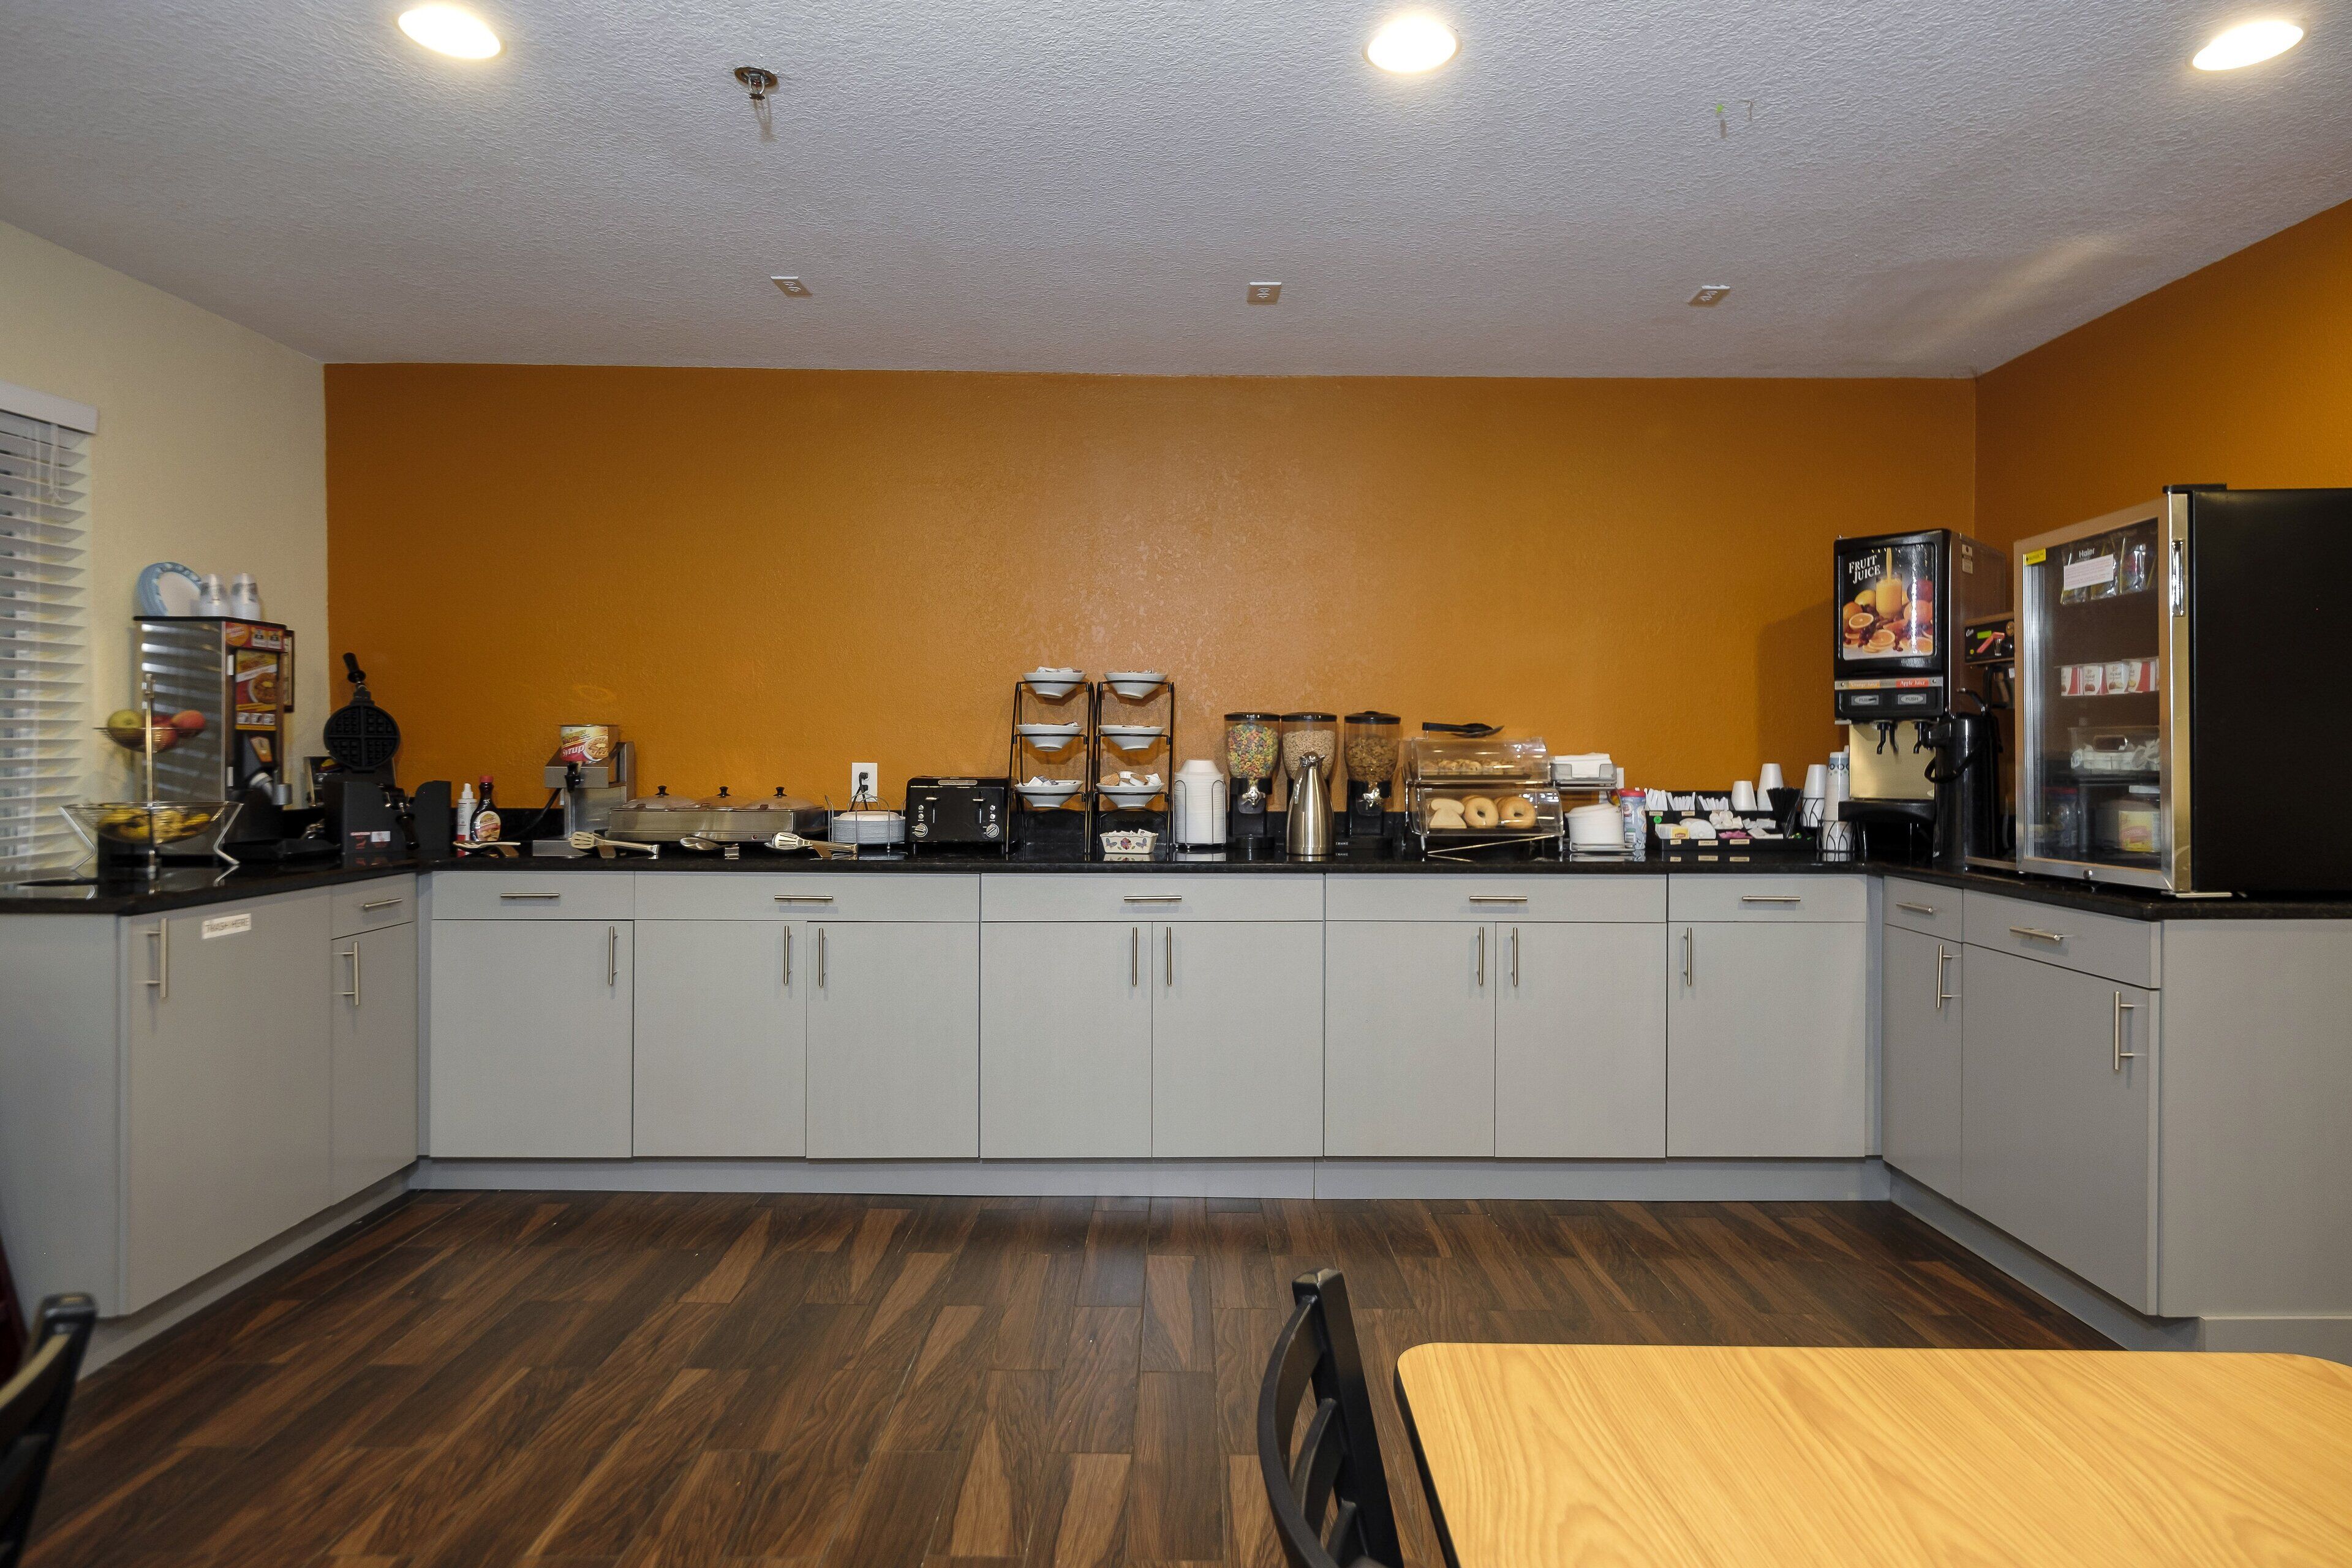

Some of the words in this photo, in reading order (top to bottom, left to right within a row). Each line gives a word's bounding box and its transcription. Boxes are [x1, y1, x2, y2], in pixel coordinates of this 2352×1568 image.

[2079, 548, 2095, 559] Haier
[1849, 555, 1877, 574] FRUIT
[1853, 565, 1880, 584] JUICE
[562, 745, 585, 757] Syrup
